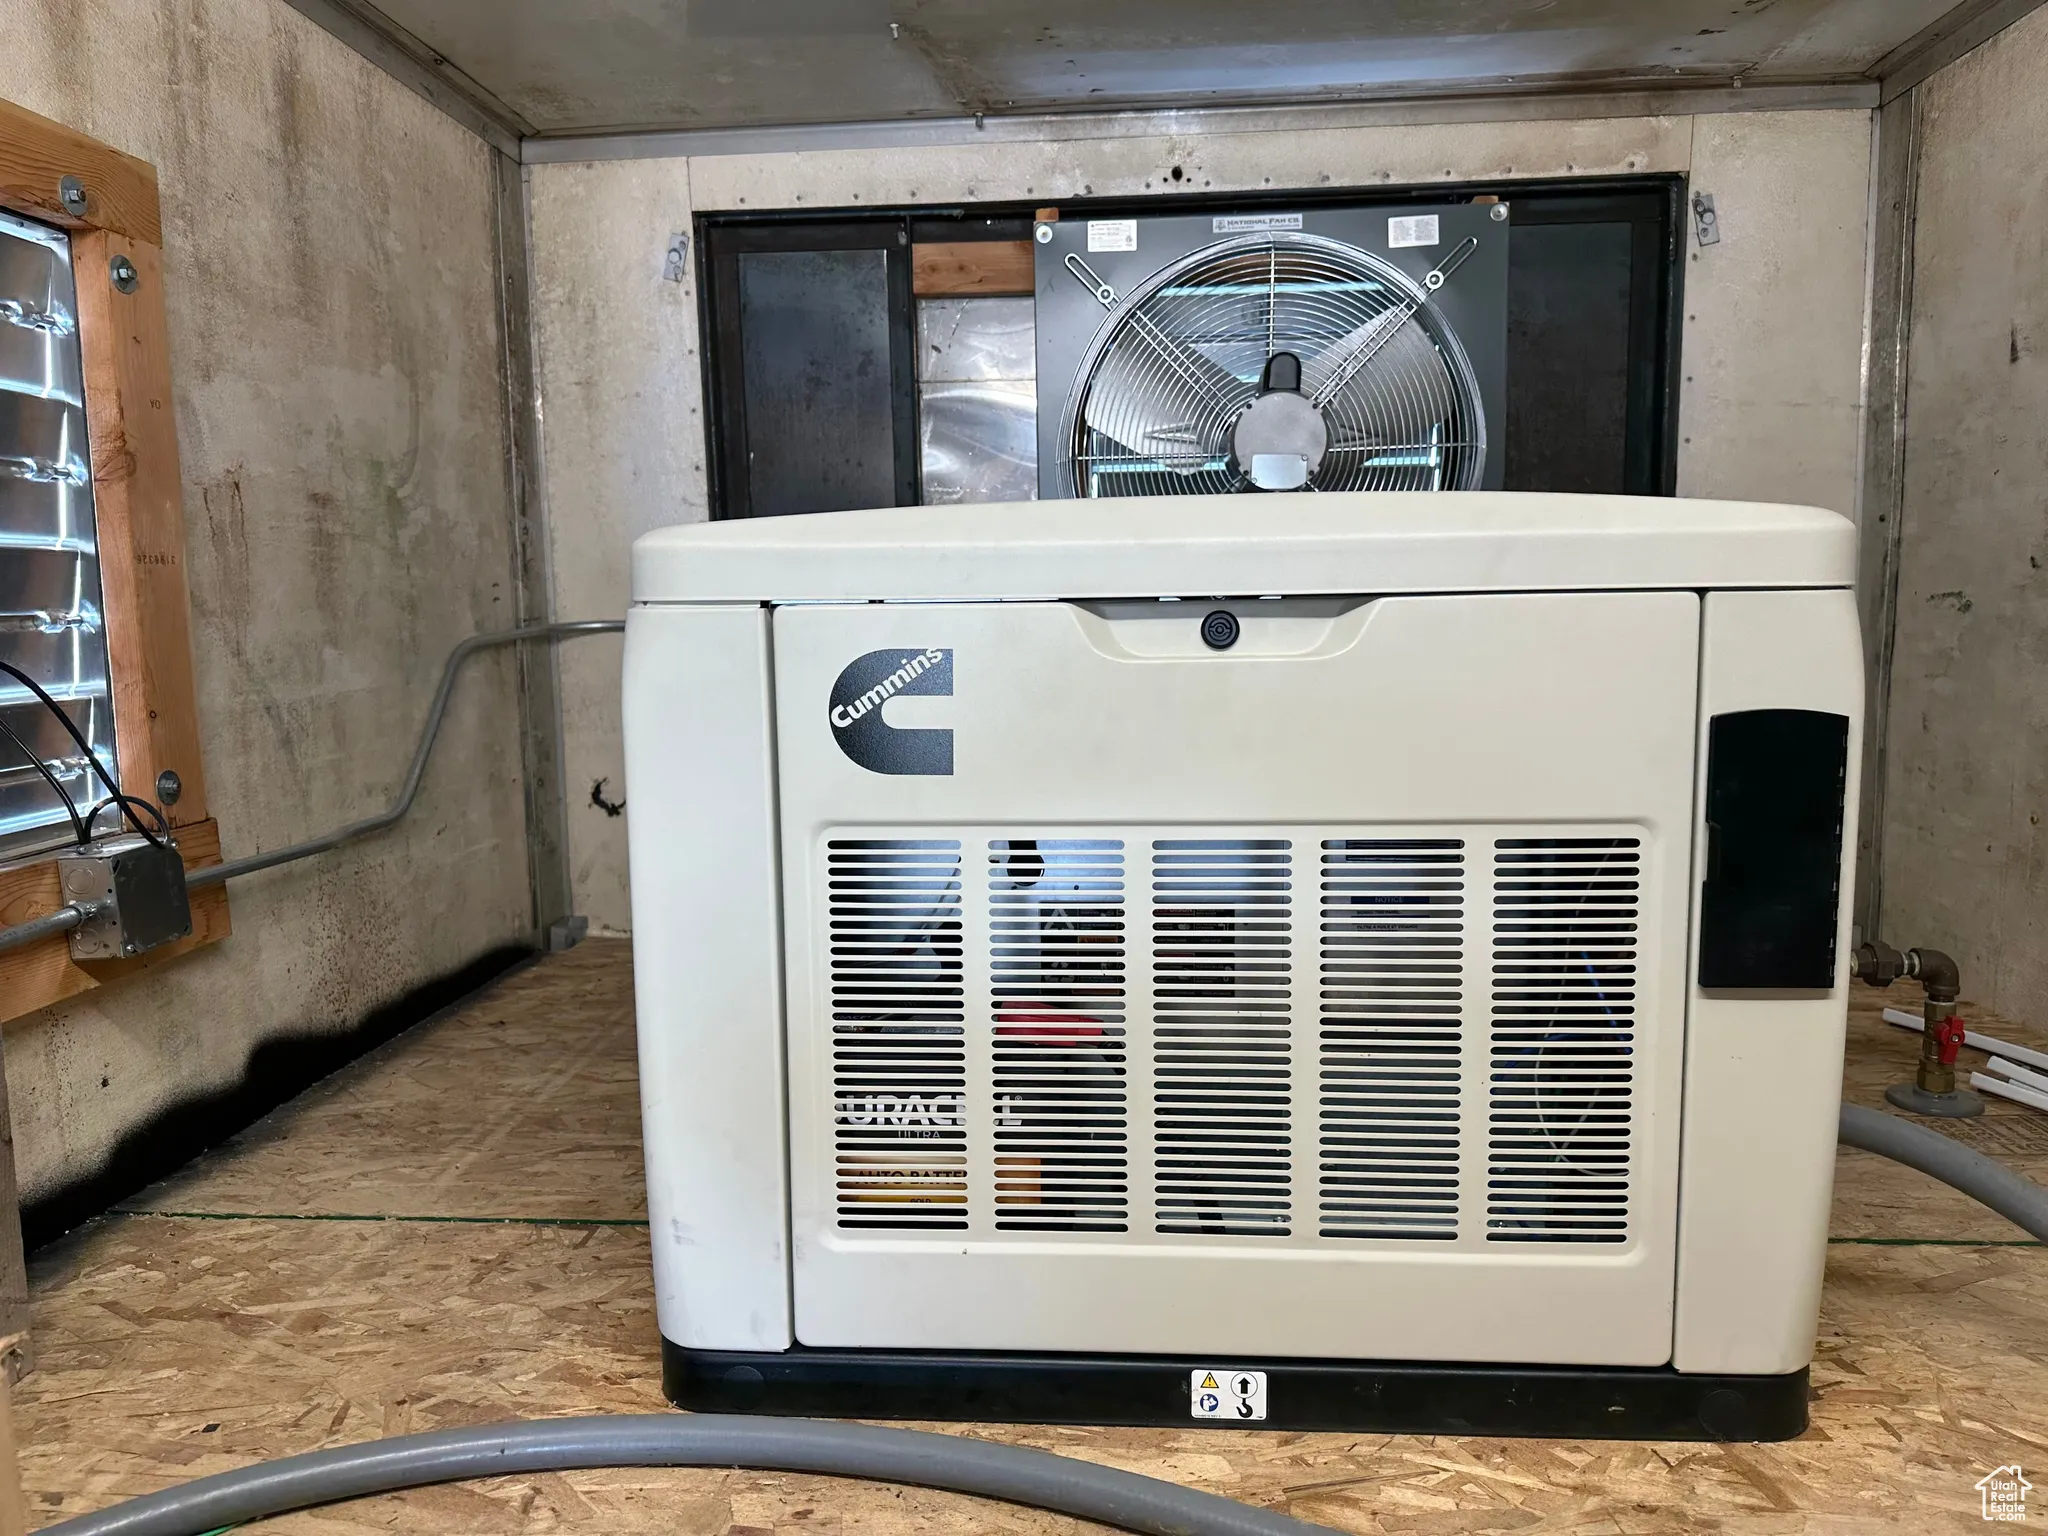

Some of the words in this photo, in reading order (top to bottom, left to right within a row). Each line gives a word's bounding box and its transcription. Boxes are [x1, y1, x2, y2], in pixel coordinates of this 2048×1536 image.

[1227, 218, 1268, 226] NATIONAL
[830, 647, 944, 729] Cummins
[855, 1170, 905, 1185] AUTO
